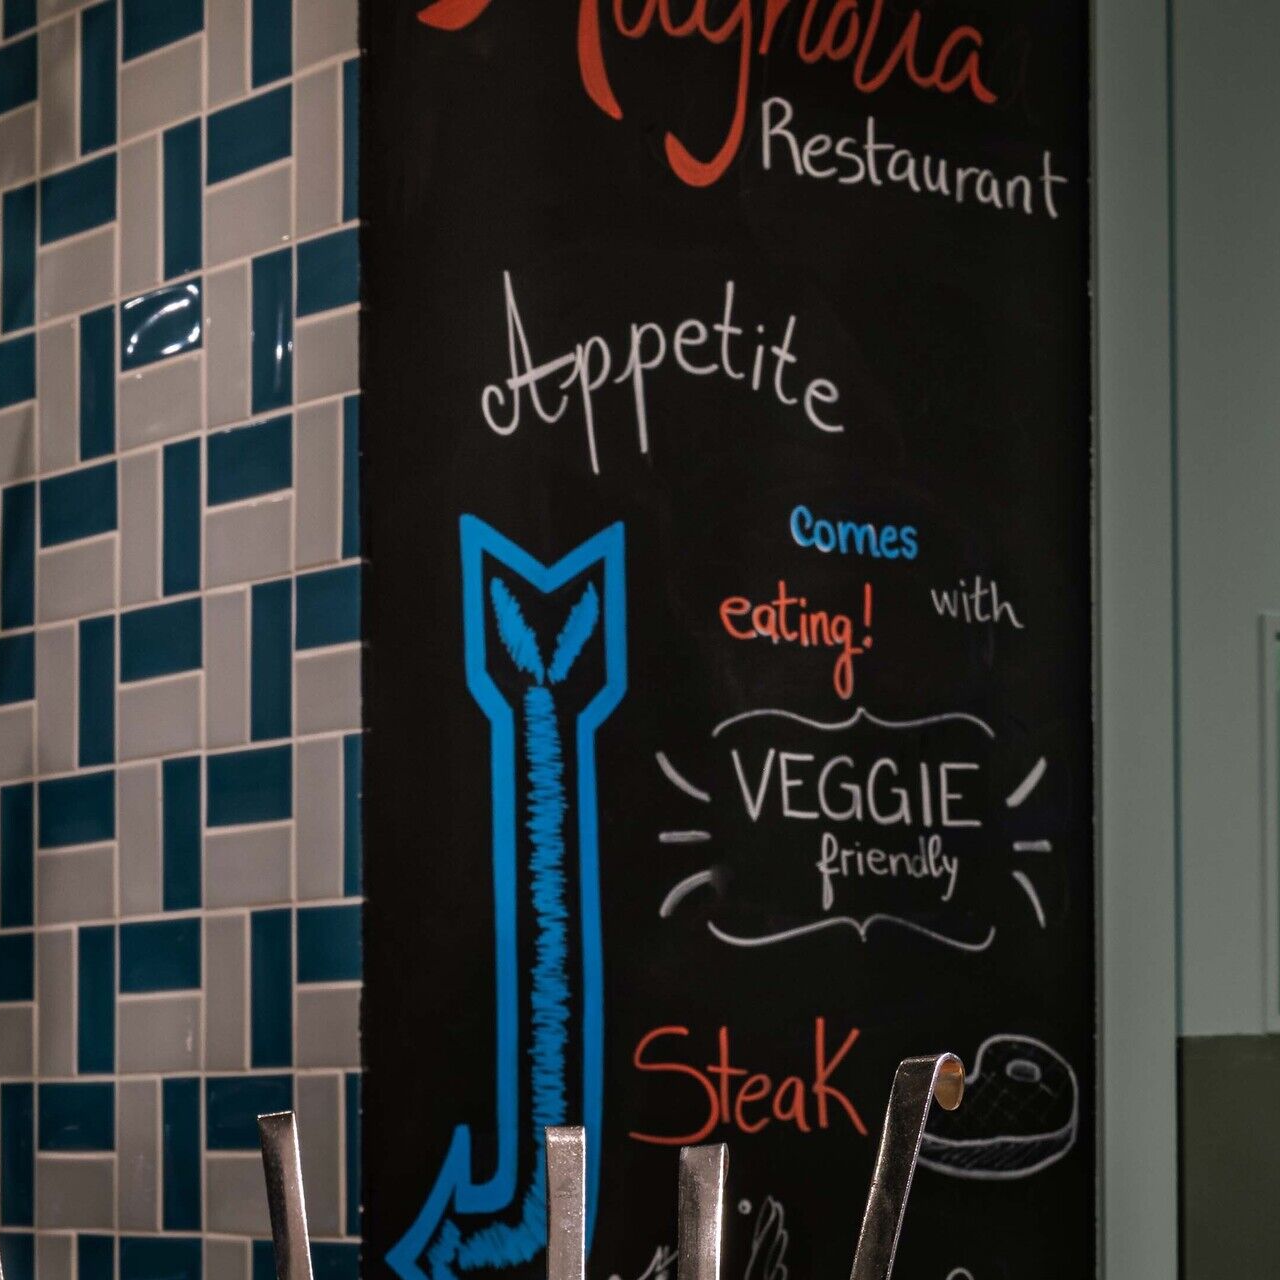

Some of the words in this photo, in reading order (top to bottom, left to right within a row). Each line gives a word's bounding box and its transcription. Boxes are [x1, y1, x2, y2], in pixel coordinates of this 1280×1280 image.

[761, 97, 1067, 218] Restaurant
[481, 270, 844, 475] Appetite
[721, 580, 873, 700] eating!
[931, 575, 1024, 629] with
[731, 748, 982, 828] VEGGIE
[816, 832, 959, 911] friendly
